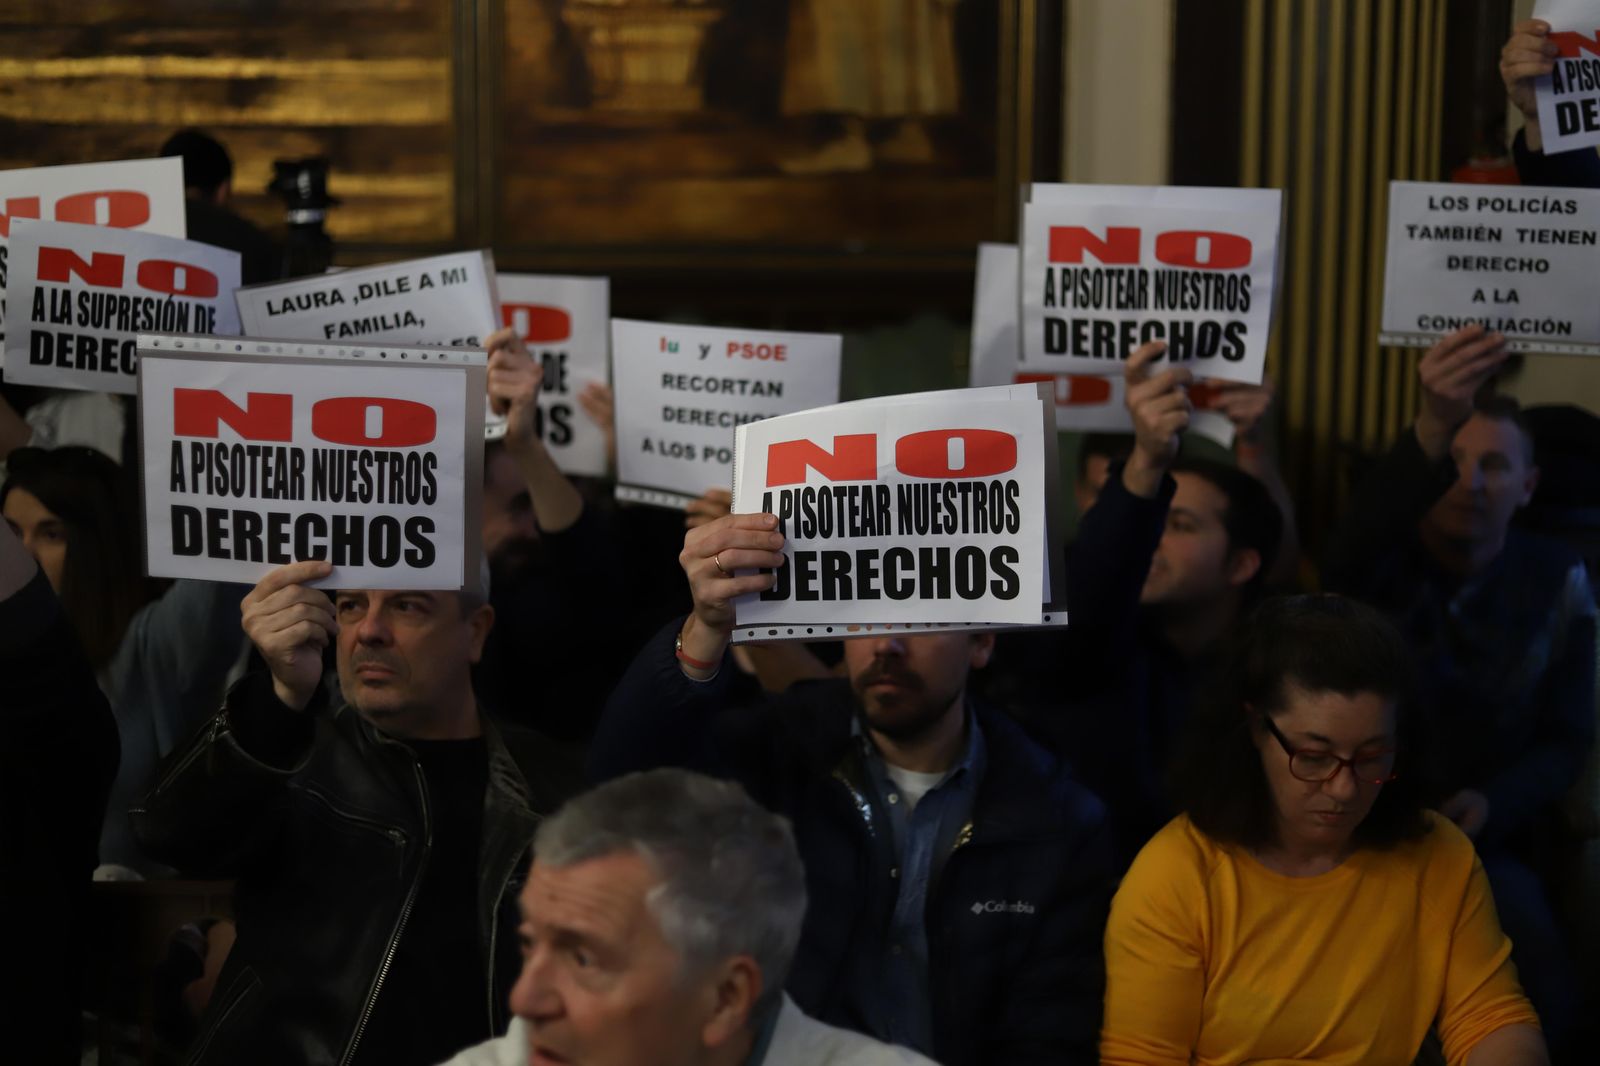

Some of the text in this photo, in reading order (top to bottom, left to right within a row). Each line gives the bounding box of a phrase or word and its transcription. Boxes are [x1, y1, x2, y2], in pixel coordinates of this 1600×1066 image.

[1428, 196, 1577, 214] LOS POLICÍAS
[1048, 226, 1252, 269] NO
[1406, 224, 1597, 245] TAMBIÉN TIENEN
[38, 247, 218, 298] NO
[1448, 256, 1549, 273] DERECHO
[32, 287, 44, 321] A
[51, 289, 71, 324] LA
[78, 292, 188, 332] SUPRESIÓN
[195, 304, 216, 333] DE
[267, 289, 345, 317] LAURA
[420, 274, 435, 290] A
[441, 267, 468, 285] MI
[1045, 268, 1250, 312] A PISOTEAR NUESTROS
[1472, 289, 1518, 303] A LA
[324, 309, 425, 339] FAMILIA,
[1045, 318, 1247, 361] DERECHOS
[30, 330, 137, 374] DEREC
[699, 344, 710, 360] y
[726, 342, 787, 361] PSOE
[662, 374, 783, 397] RECORTAN
[174, 388, 437, 447] NO
[643, 439, 653, 452] A
[661, 442, 695, 460] LOS
[766, 429, 1017, 487] NO
[170, 440, 437, 505] A PISOTEAR NUESTROS
[780, 485, 891, 539] PISOTEAR
[897, 480, 1020, 535] NUESTROS
[171, 505, 436, 568] DERECHOS
[760, 546, 1020, 601] DERECHOS
[984, 900, 1035, 914] Columbia
